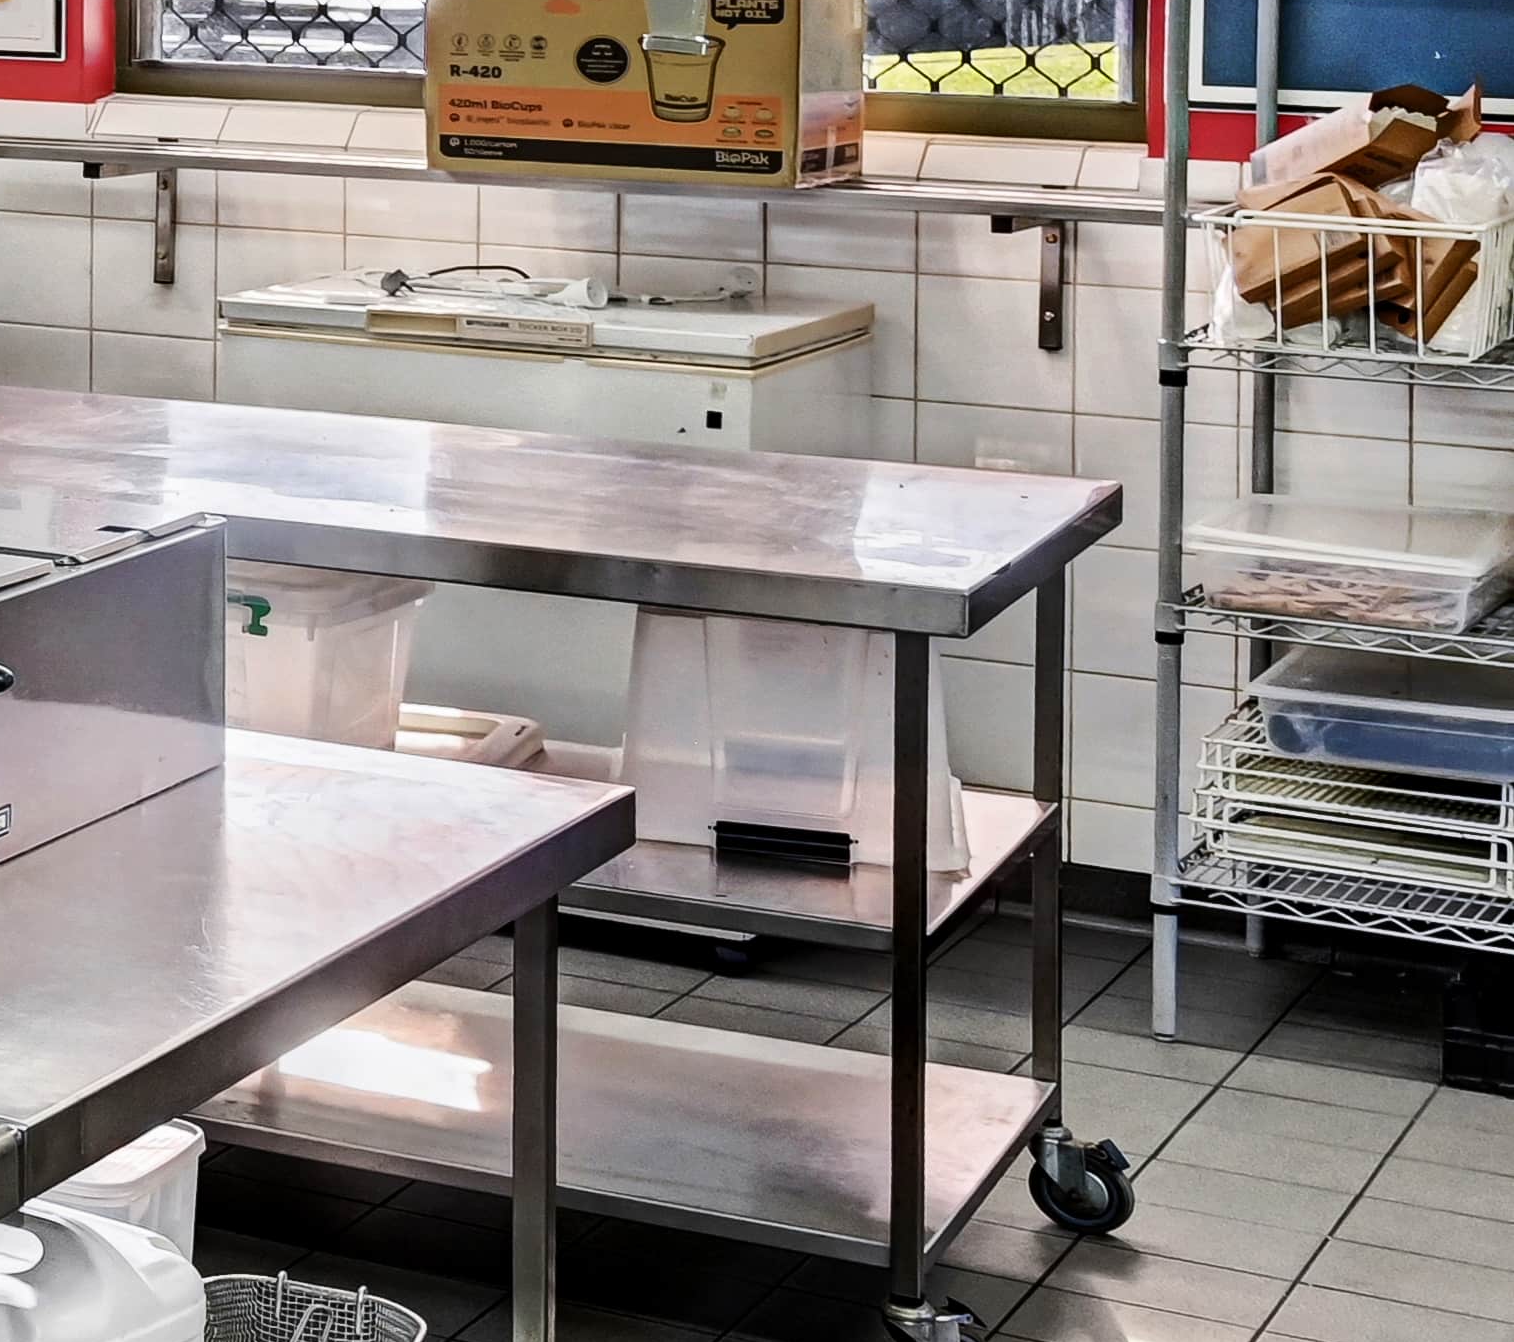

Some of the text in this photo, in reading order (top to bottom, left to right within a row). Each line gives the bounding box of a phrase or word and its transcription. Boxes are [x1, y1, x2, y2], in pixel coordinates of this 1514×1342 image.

[715, 0, 779, 9] PLANTS
[715, 10, 741, 18] NOT
[450, 64, 502, 79] R-420
[449, 99, 543, 113] 420ml BioCups
[715, 150, 770, 165] BioPak
